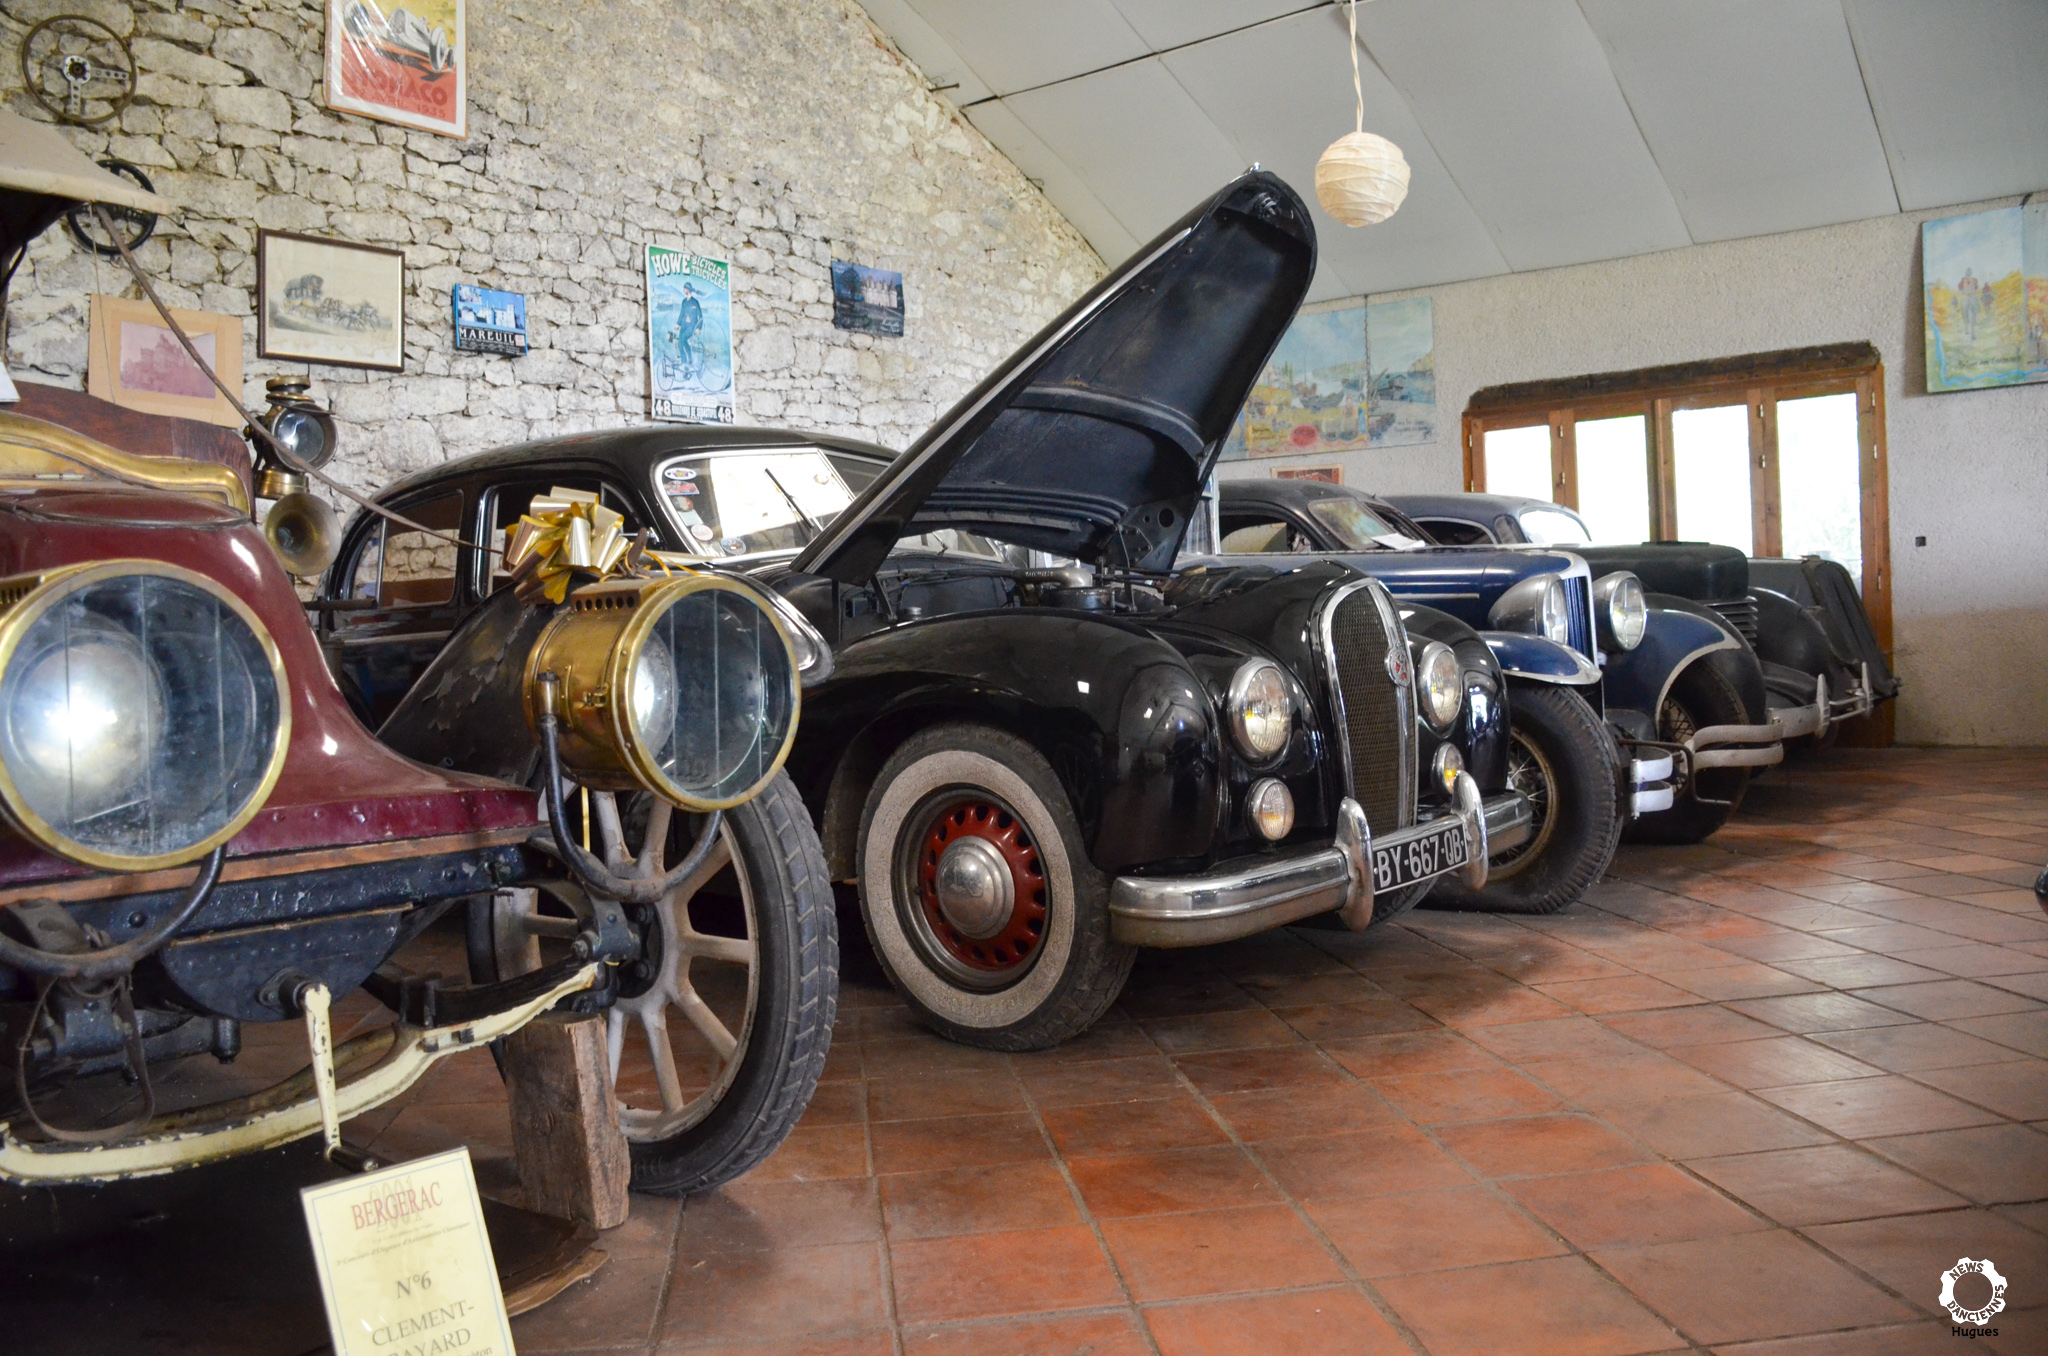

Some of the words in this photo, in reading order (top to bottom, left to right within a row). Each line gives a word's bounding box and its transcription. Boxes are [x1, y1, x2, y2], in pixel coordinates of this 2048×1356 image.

[650, 252, 692, 277] HOWE
[691, 255, 727, 280] BICYCLES
[691, 265, 728, 291] TRICYCLES
[459, 327, 515, 344] MAREUIL
[655, 399, 672, 417] 48
[717, 406, 733, 423] 48
[1376, 829, 1463, 888] BY-667-QB
[351, 1181, 444, 1231] BERGERAC
[371, 1299, 475, 1346] CLEMENT-
[387, 1327, 471, 1356] YARD
